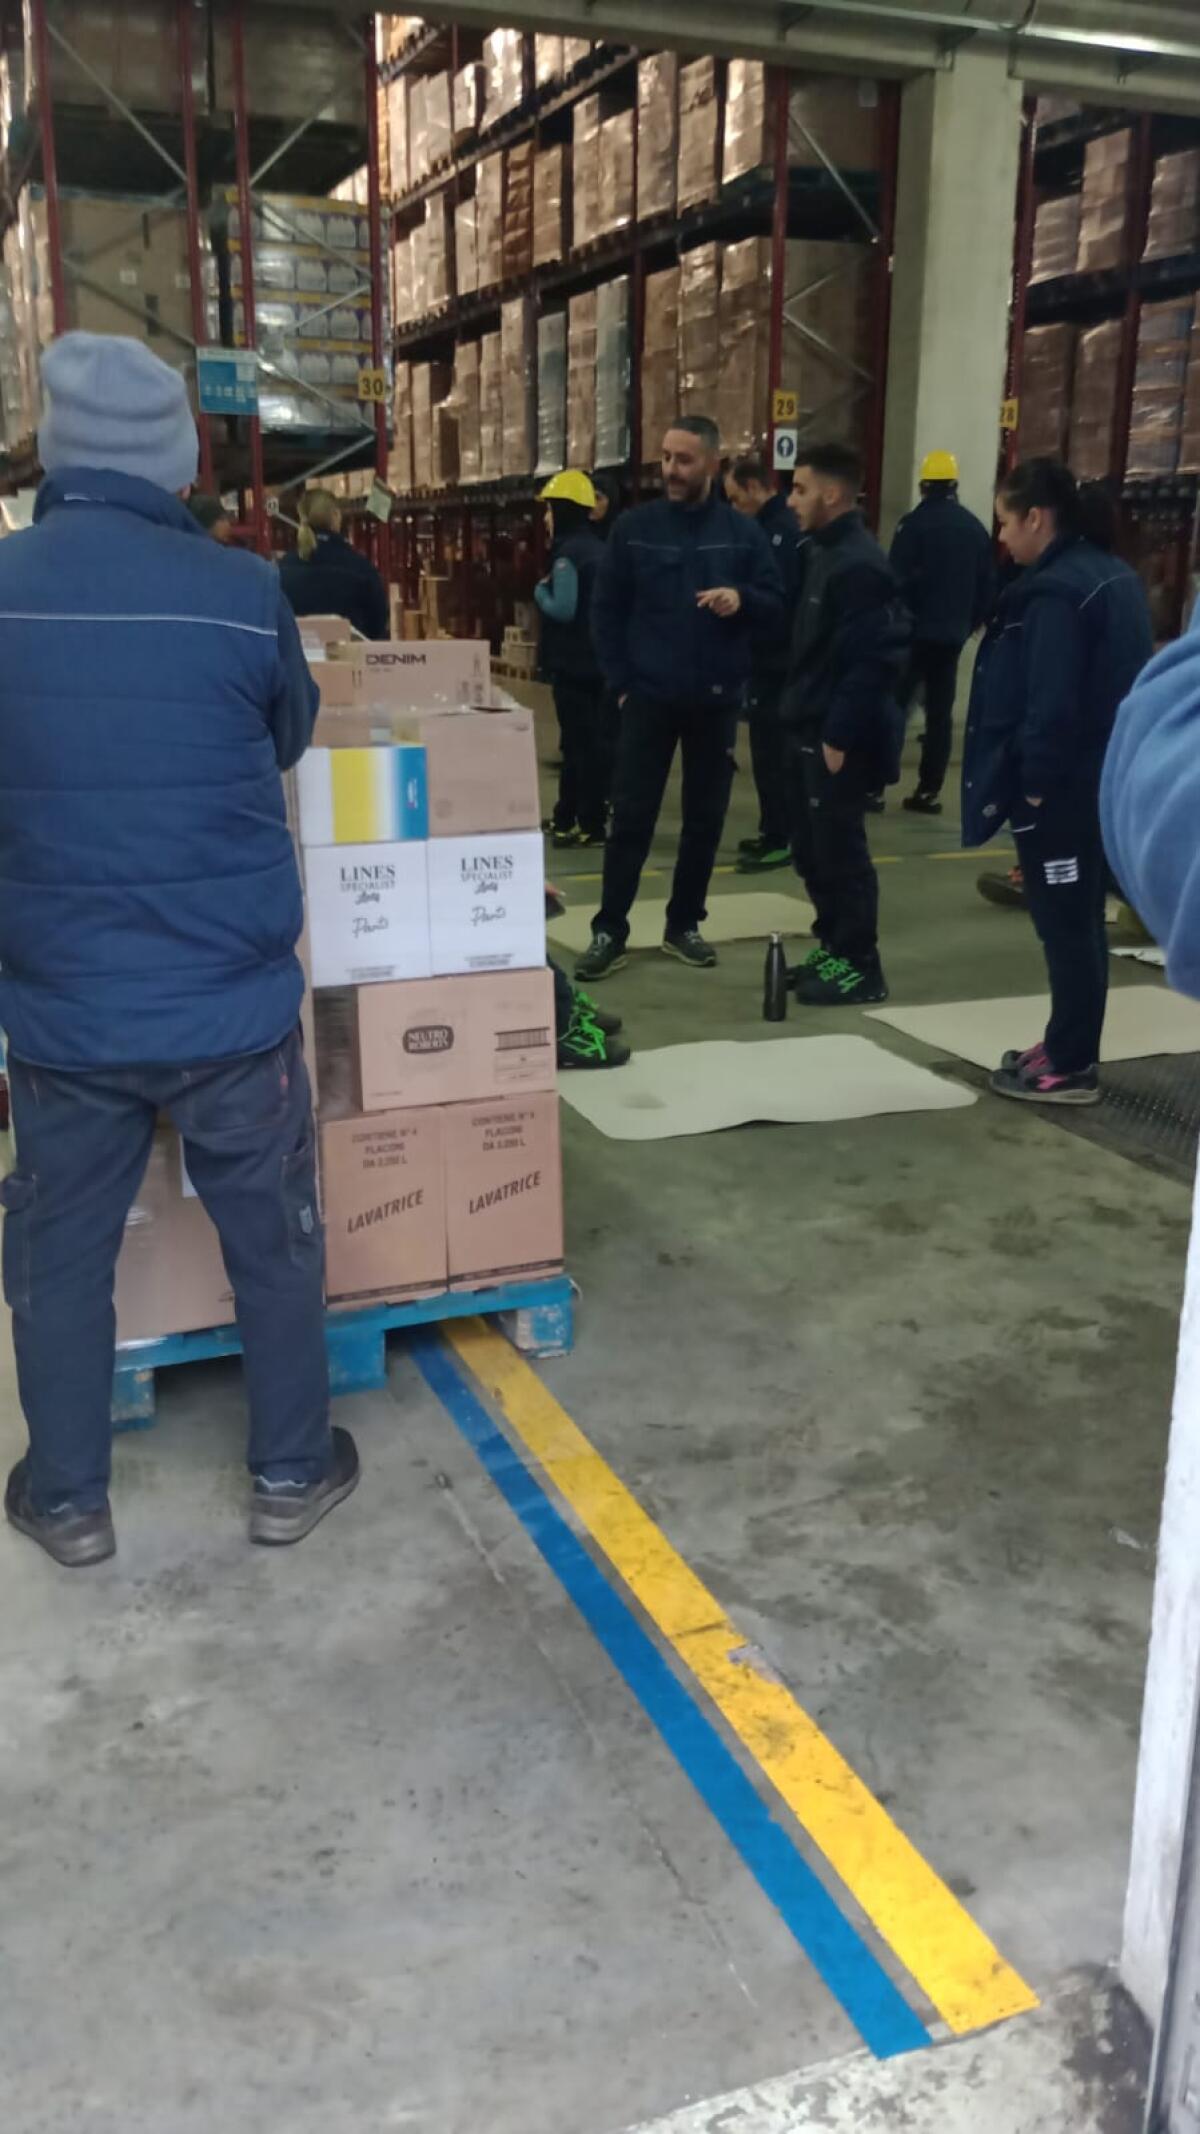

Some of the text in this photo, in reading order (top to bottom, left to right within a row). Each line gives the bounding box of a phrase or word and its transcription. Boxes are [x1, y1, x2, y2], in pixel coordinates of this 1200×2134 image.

[362, 378, 384, 396] 30
[776, 398, 795, 416] 29
[366, 653, 427, 666] DENIM
[461, 855, 513, 872] LINES
[340, 864, 395, 882] LINES
[461, 870, 513, 882] SPECIALIST
[340, 880, 395, 892] SPECIALIST
[408, 1028, 448, 1042] NEUTRO
[468, 1171, 542, 1215] LAVATRICE
[347, 1189, 425, 1234] LAVATRICE
